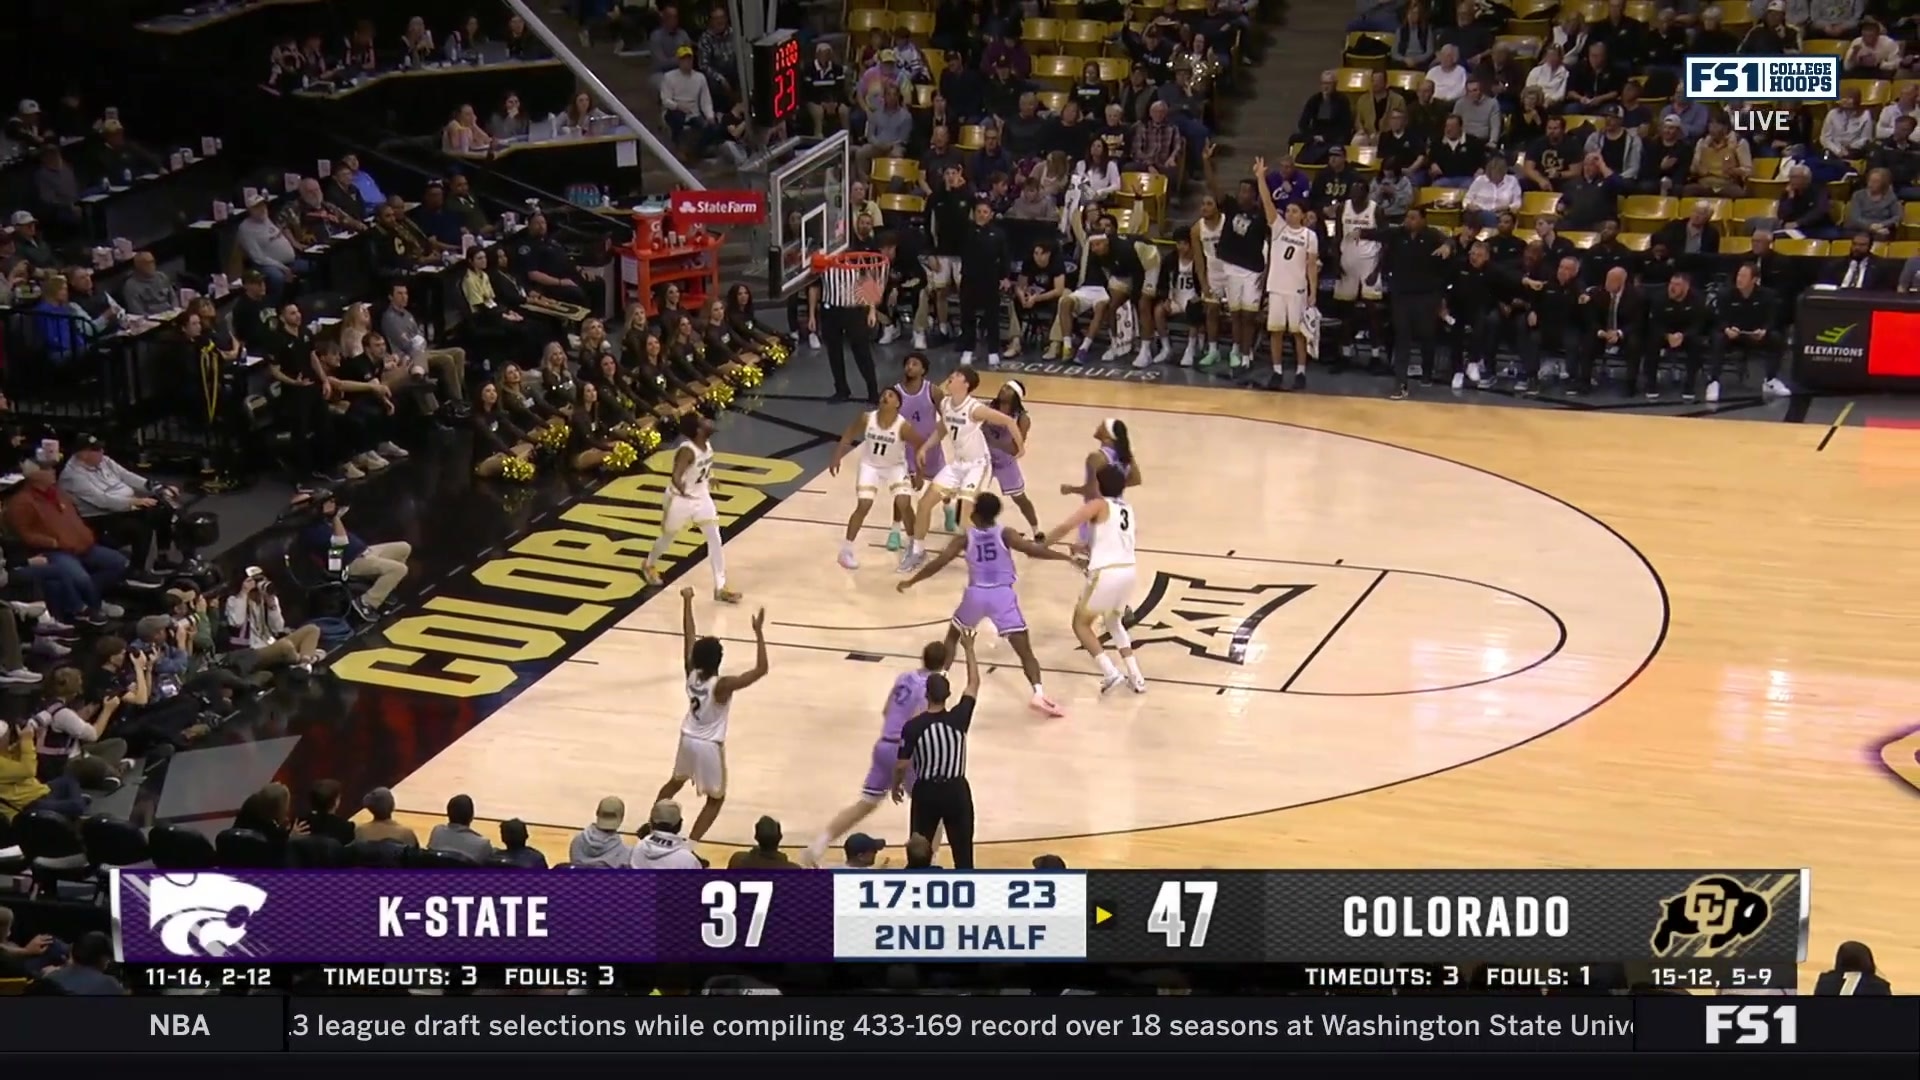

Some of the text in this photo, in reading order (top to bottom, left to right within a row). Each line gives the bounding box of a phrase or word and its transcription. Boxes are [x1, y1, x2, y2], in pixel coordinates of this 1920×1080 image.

[774, 68, 796, 118] 23
[1283, 245, 1296, 261] 0
[1180, 277, 1194, 291] 15
[1803, 345, 1864, 357] ELEVATIONS
[912, 410, 921, 423] 4
[950, 425, 959, 441] 7
[872, 442, 887, 456] 11
[1119, 508, 1130, 531] 3
[975, 541, 998, 563] 15
[690, 696, 701, 721] 2
